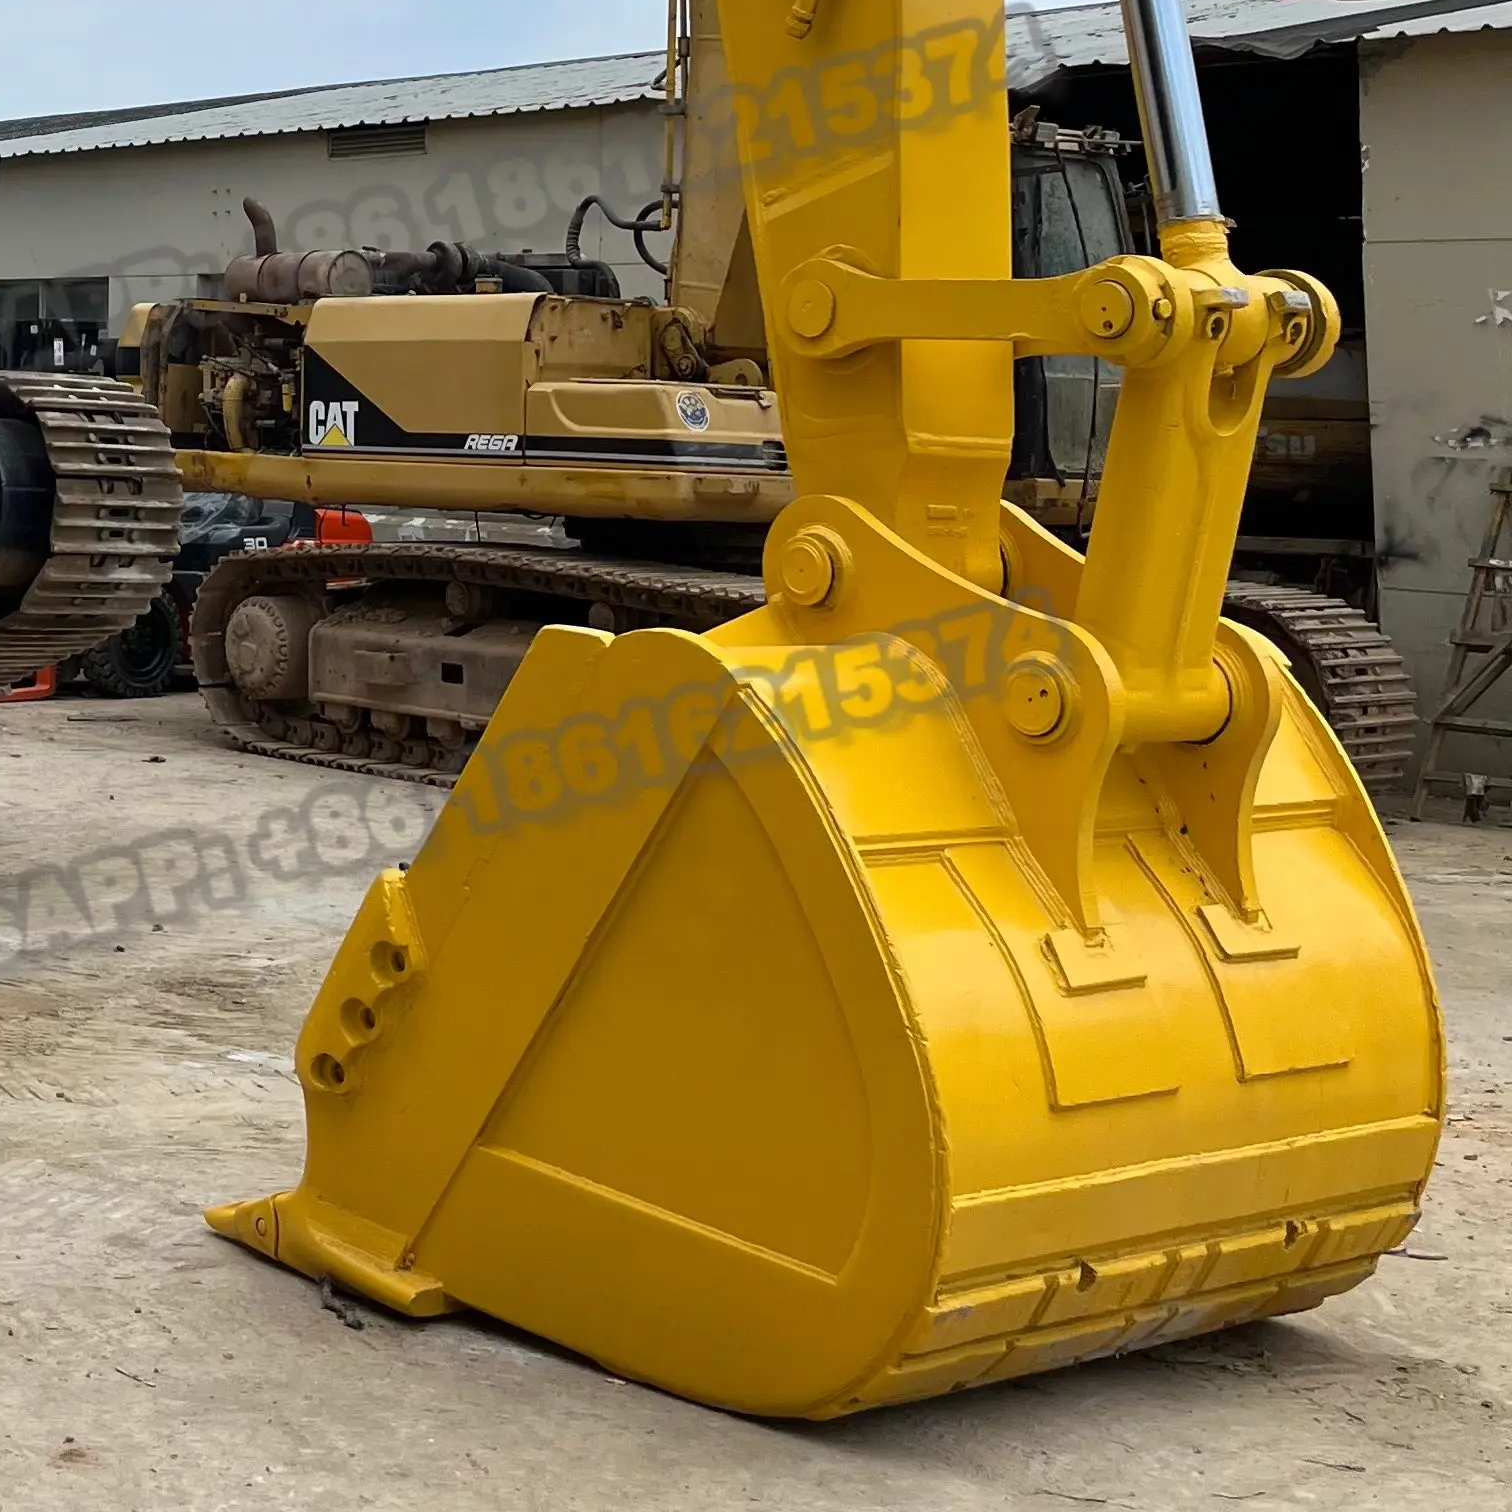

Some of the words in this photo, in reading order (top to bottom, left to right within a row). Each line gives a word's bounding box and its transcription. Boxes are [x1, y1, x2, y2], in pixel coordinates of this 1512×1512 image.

[309, 400, 359, 446] CAT
[464, 434, 518, 451] REGA
[243, 537, 268, 550] 30
